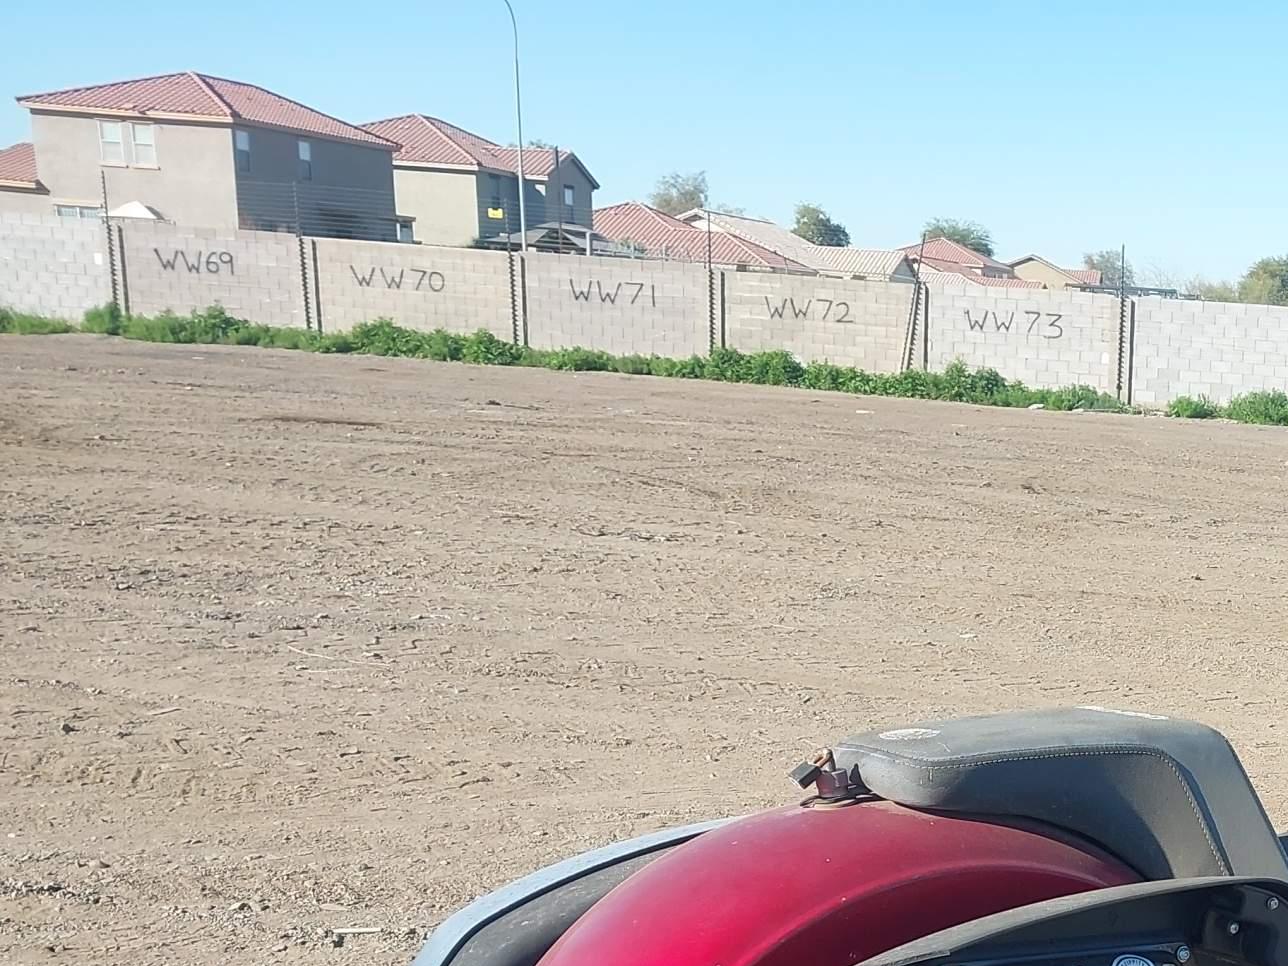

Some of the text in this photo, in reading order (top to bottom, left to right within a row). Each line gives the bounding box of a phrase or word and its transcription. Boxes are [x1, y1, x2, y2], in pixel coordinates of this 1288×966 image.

[153, 248, 235, 276] WW69
[349, 265, 446, 292] WW70
[569, 278, 656, 307] WW71
[764, 295, 854, 323] WW72
[963, 309, 1064, 339] WW73
